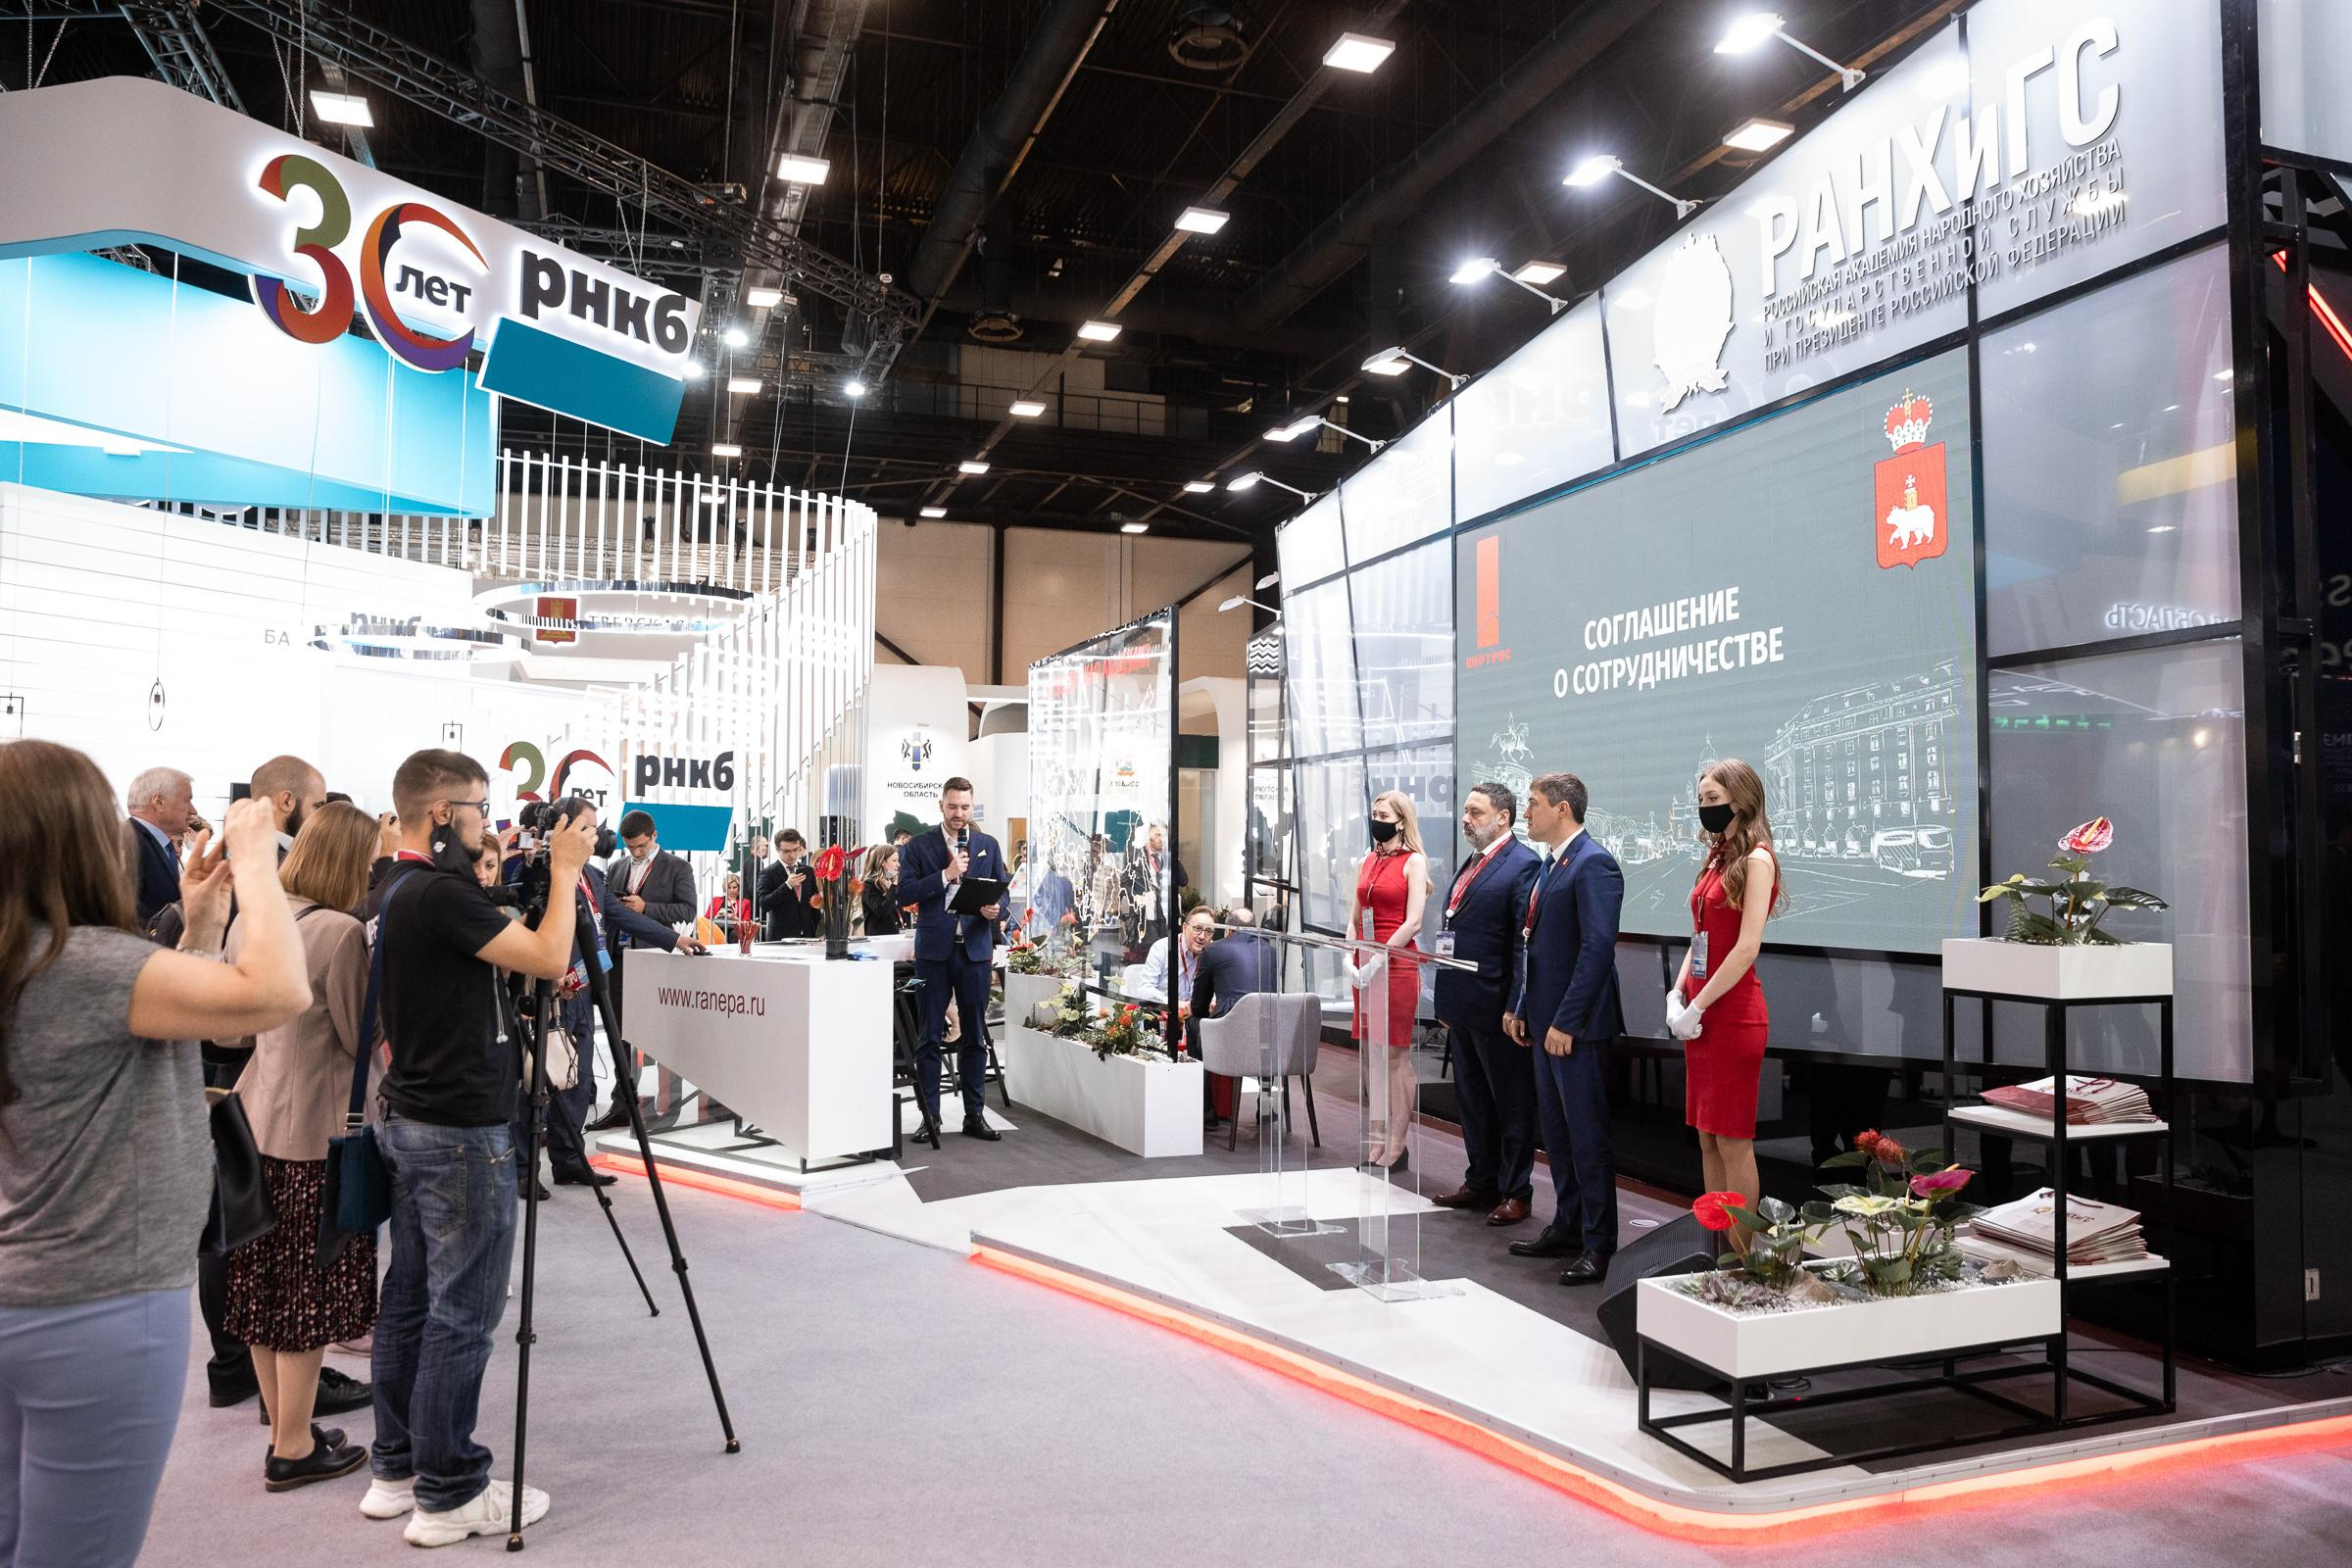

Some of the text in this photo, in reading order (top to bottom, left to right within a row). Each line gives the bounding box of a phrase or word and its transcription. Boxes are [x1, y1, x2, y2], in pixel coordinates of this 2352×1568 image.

[1760, 16, 2121, 299] РАНХиГС
[253, 154, 490, 373] 30
[1764, 137, 2122, 321] РОССИЙСКАЯ АКАДЕМИЯ НАРОДНОГО ХОЗЯЙСТВА
[1764, 168, 2125, 347] И ГОСУДАРСТВЕННОЙ СЛУЖБЫ
[395, 264, 472, 314] лет
[520, 250, 689, 356] рнкб
[1764, 200, 2126, 372] ПРИ ПРЕЗИДЕНТЕ РОССИЙСКОЙ ФЕДЕРАЦИИ
[1553, 626, 1785, 699] О СОТРУДНИЧЕСТВЕ
[1584, 586, 1740, 651] СОГЛАШЕНИЕ
[635, 751, 734, 797] рнкб
[887, 781, 943, 790] НОВОСИБИРСК
[658, 986, 766, 1019] www.ranepa.ru
